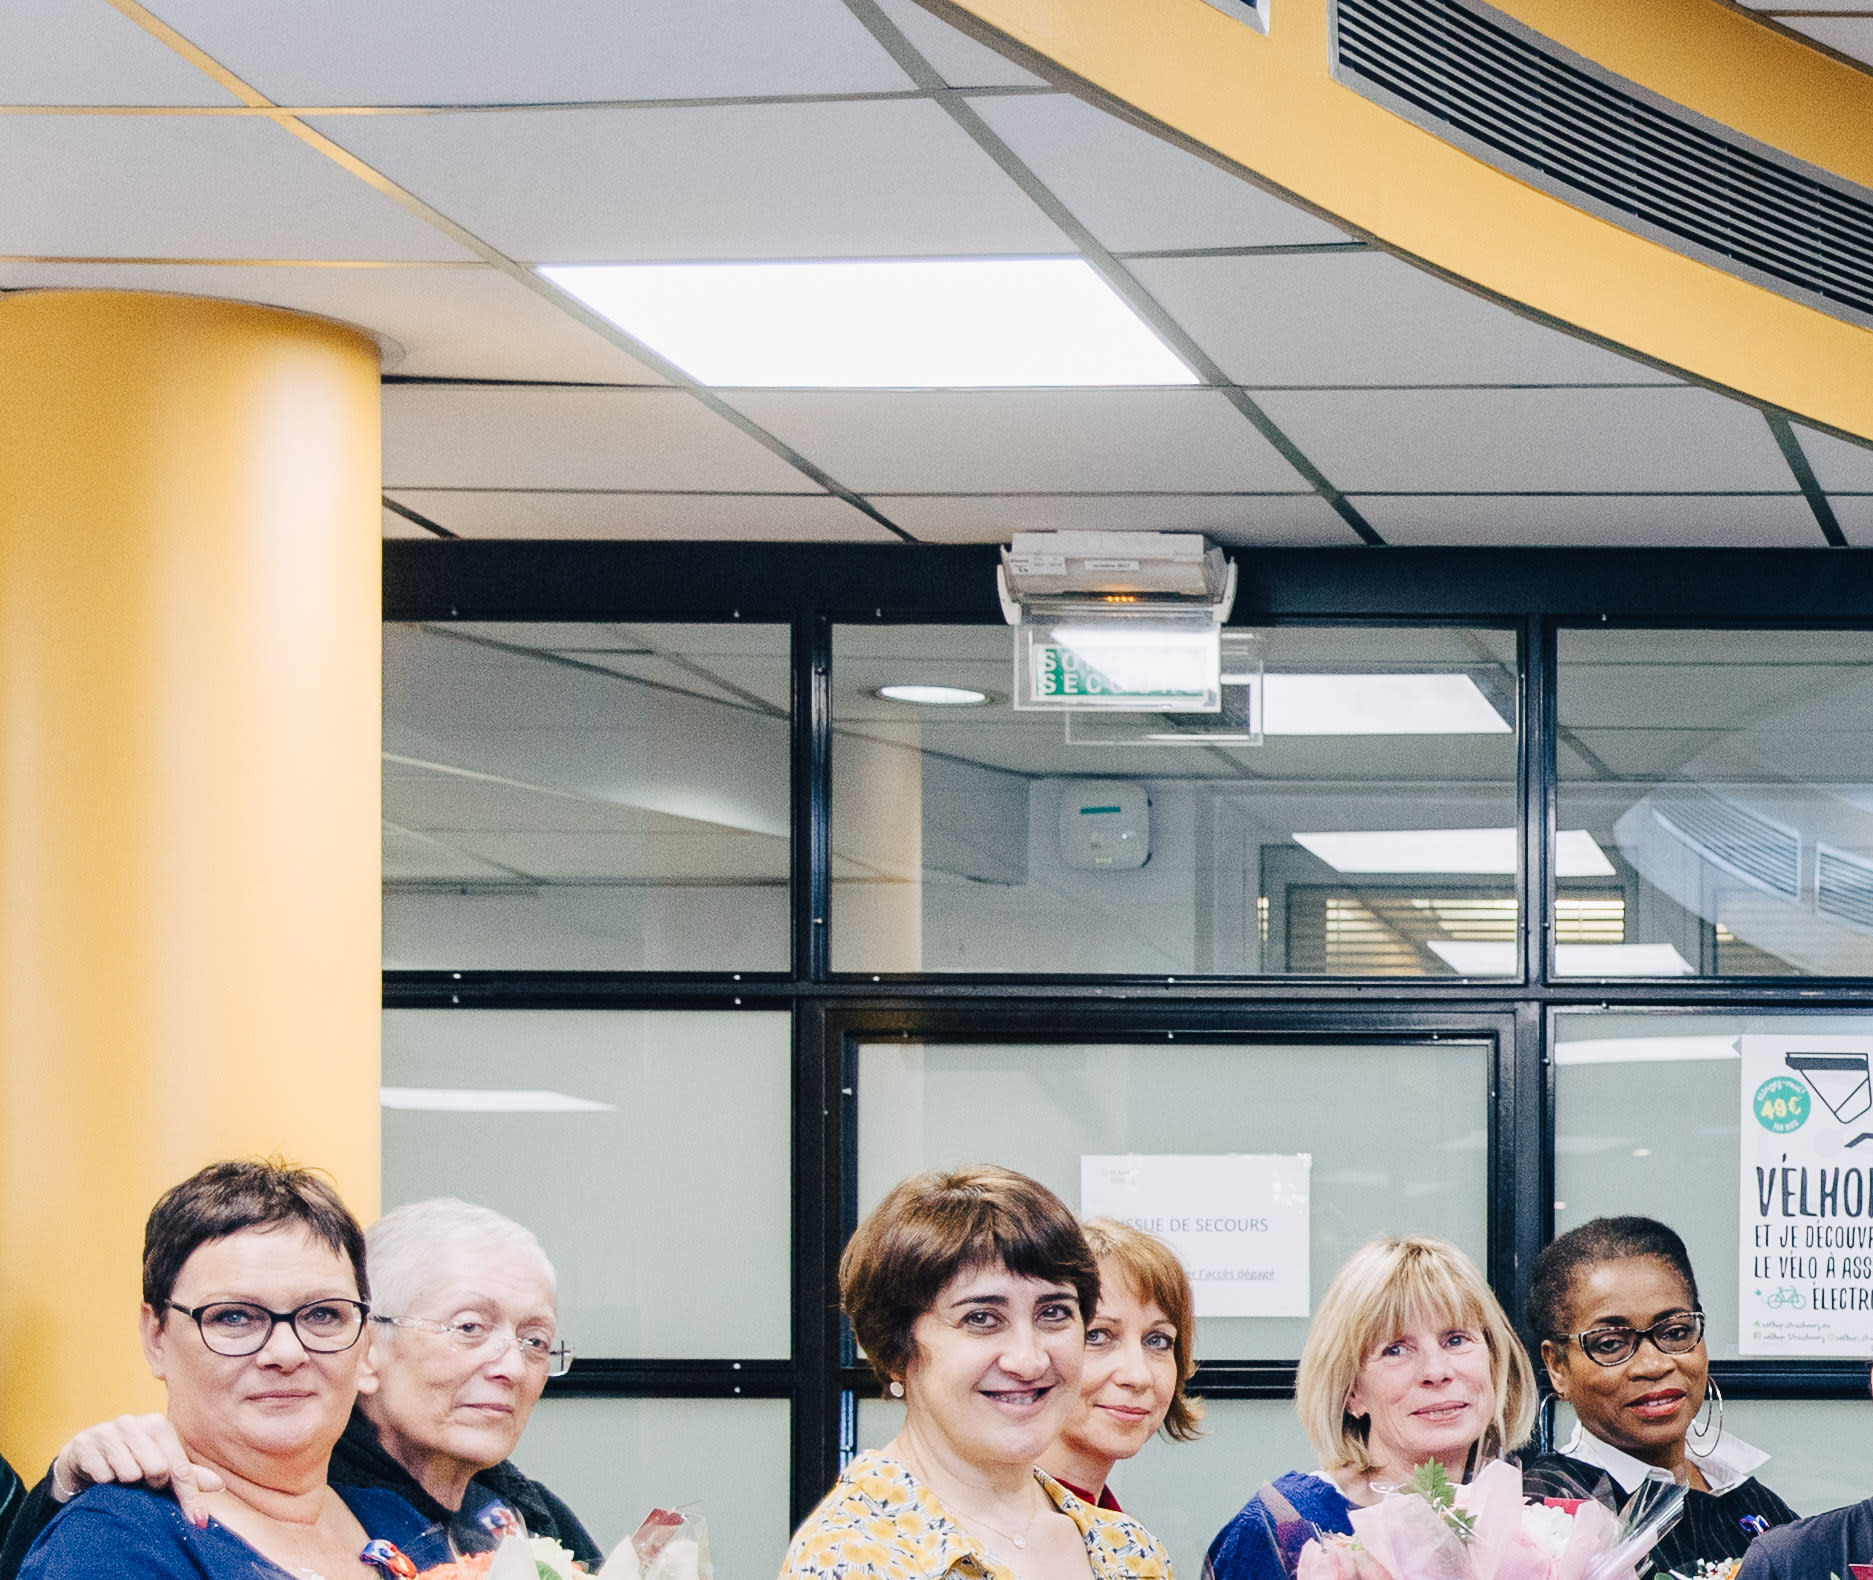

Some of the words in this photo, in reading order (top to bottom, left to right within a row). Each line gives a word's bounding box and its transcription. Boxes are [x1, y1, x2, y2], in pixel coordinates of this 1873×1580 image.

[1170, 1217, 1191, 1233] DE
[1195, 1217, 1269, 1233] SECOURS
[1754, 1224, 1772, 1249] ET
[1779, 1224, 1798, 1249] JE
[1754, 1255, 1772, 1280] LE
[1779, 1249, 1818, 1280] VÉLO
[1825, 1251, 1836, 1280] À
